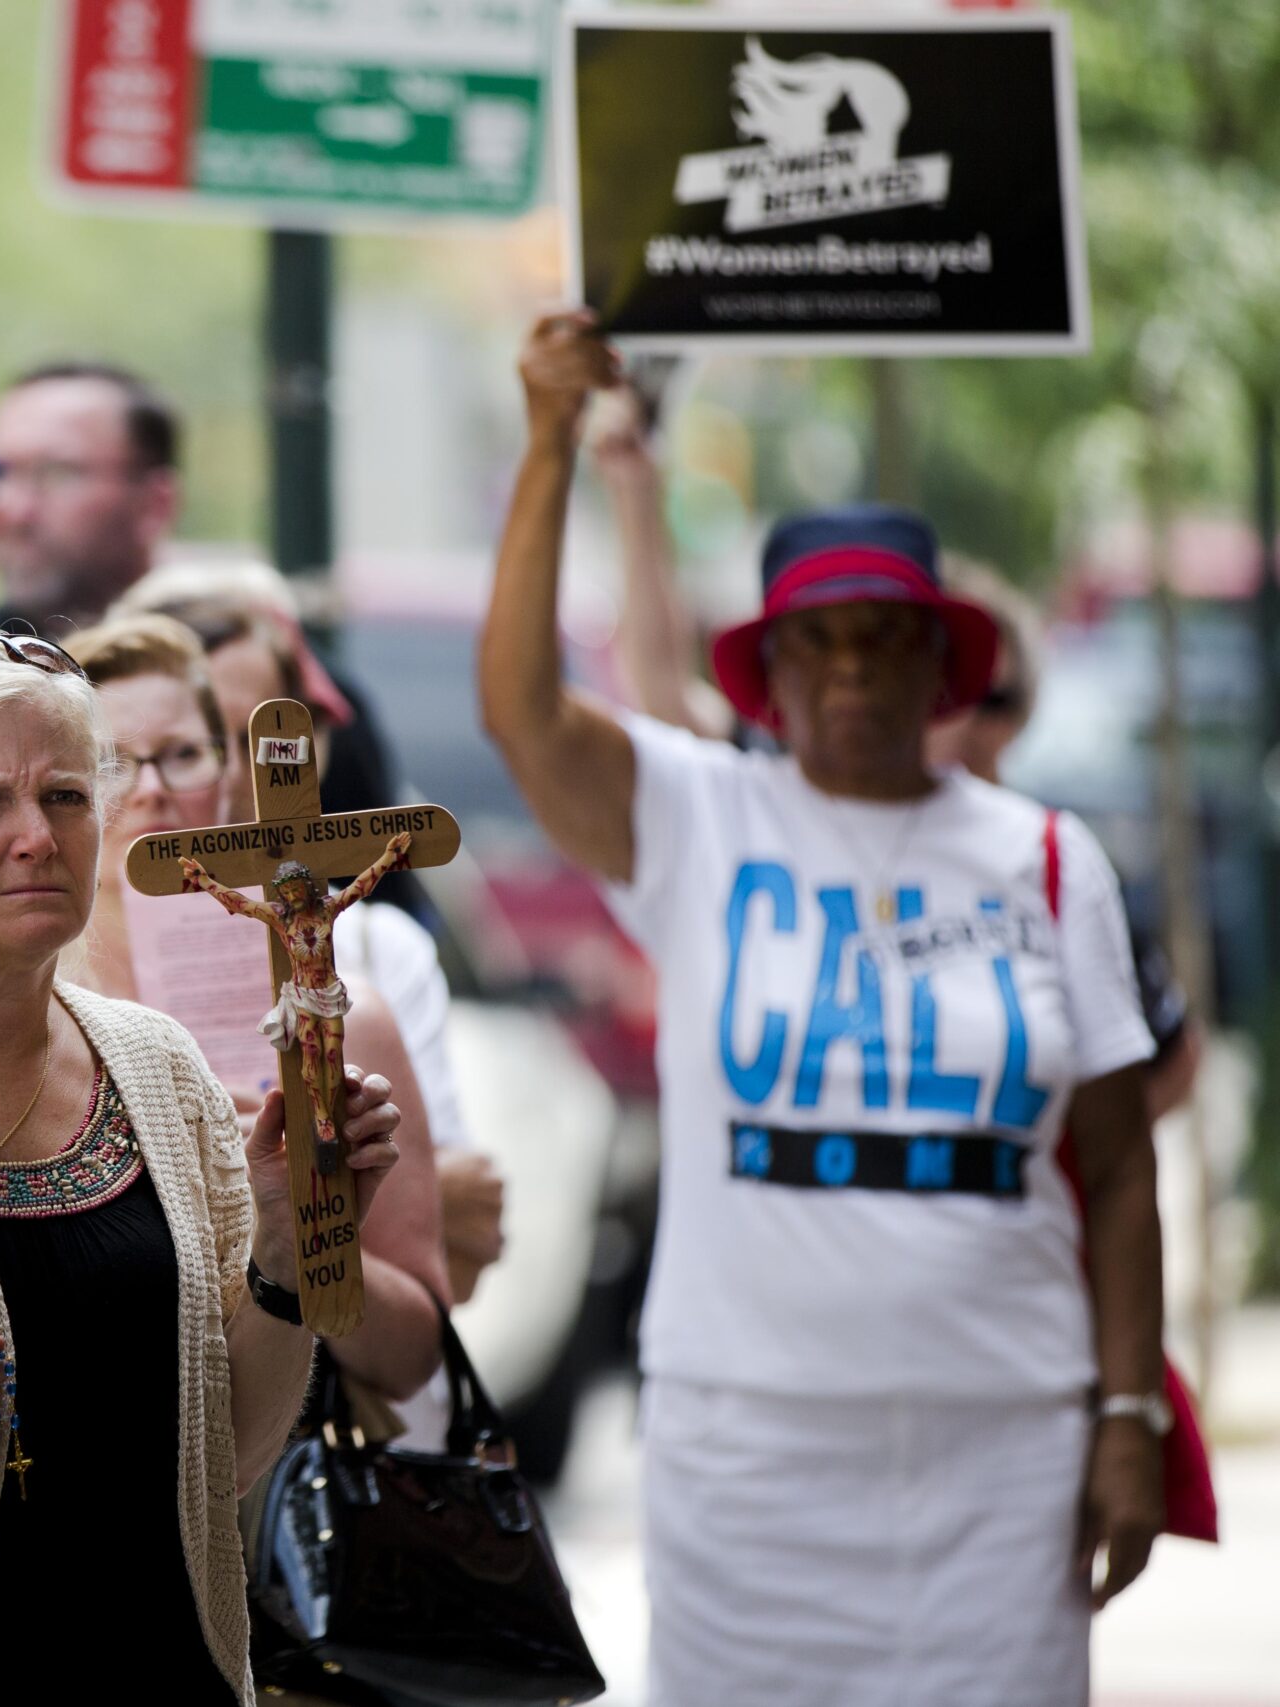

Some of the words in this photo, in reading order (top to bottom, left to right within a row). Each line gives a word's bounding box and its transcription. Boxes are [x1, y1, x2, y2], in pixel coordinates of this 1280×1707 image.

[646, 233, 991, 282] #WomenBetrayed
[276, 710, 281, 730] I
[270, 765, 300, 788] AM
[146, 838, 182, 860] THE
[190, 825, 295, 855] AGONIZING
[303, 817, 362, 844] JESUS
[370, 811, 435, 836] CHRIST
[720, 860, 1050, 1128] CALL
[299, 1194, 345, 1225] WHO
[302, 1223, 355, 1259] LOVES
[305, 1260, 345, 1290] YOU
